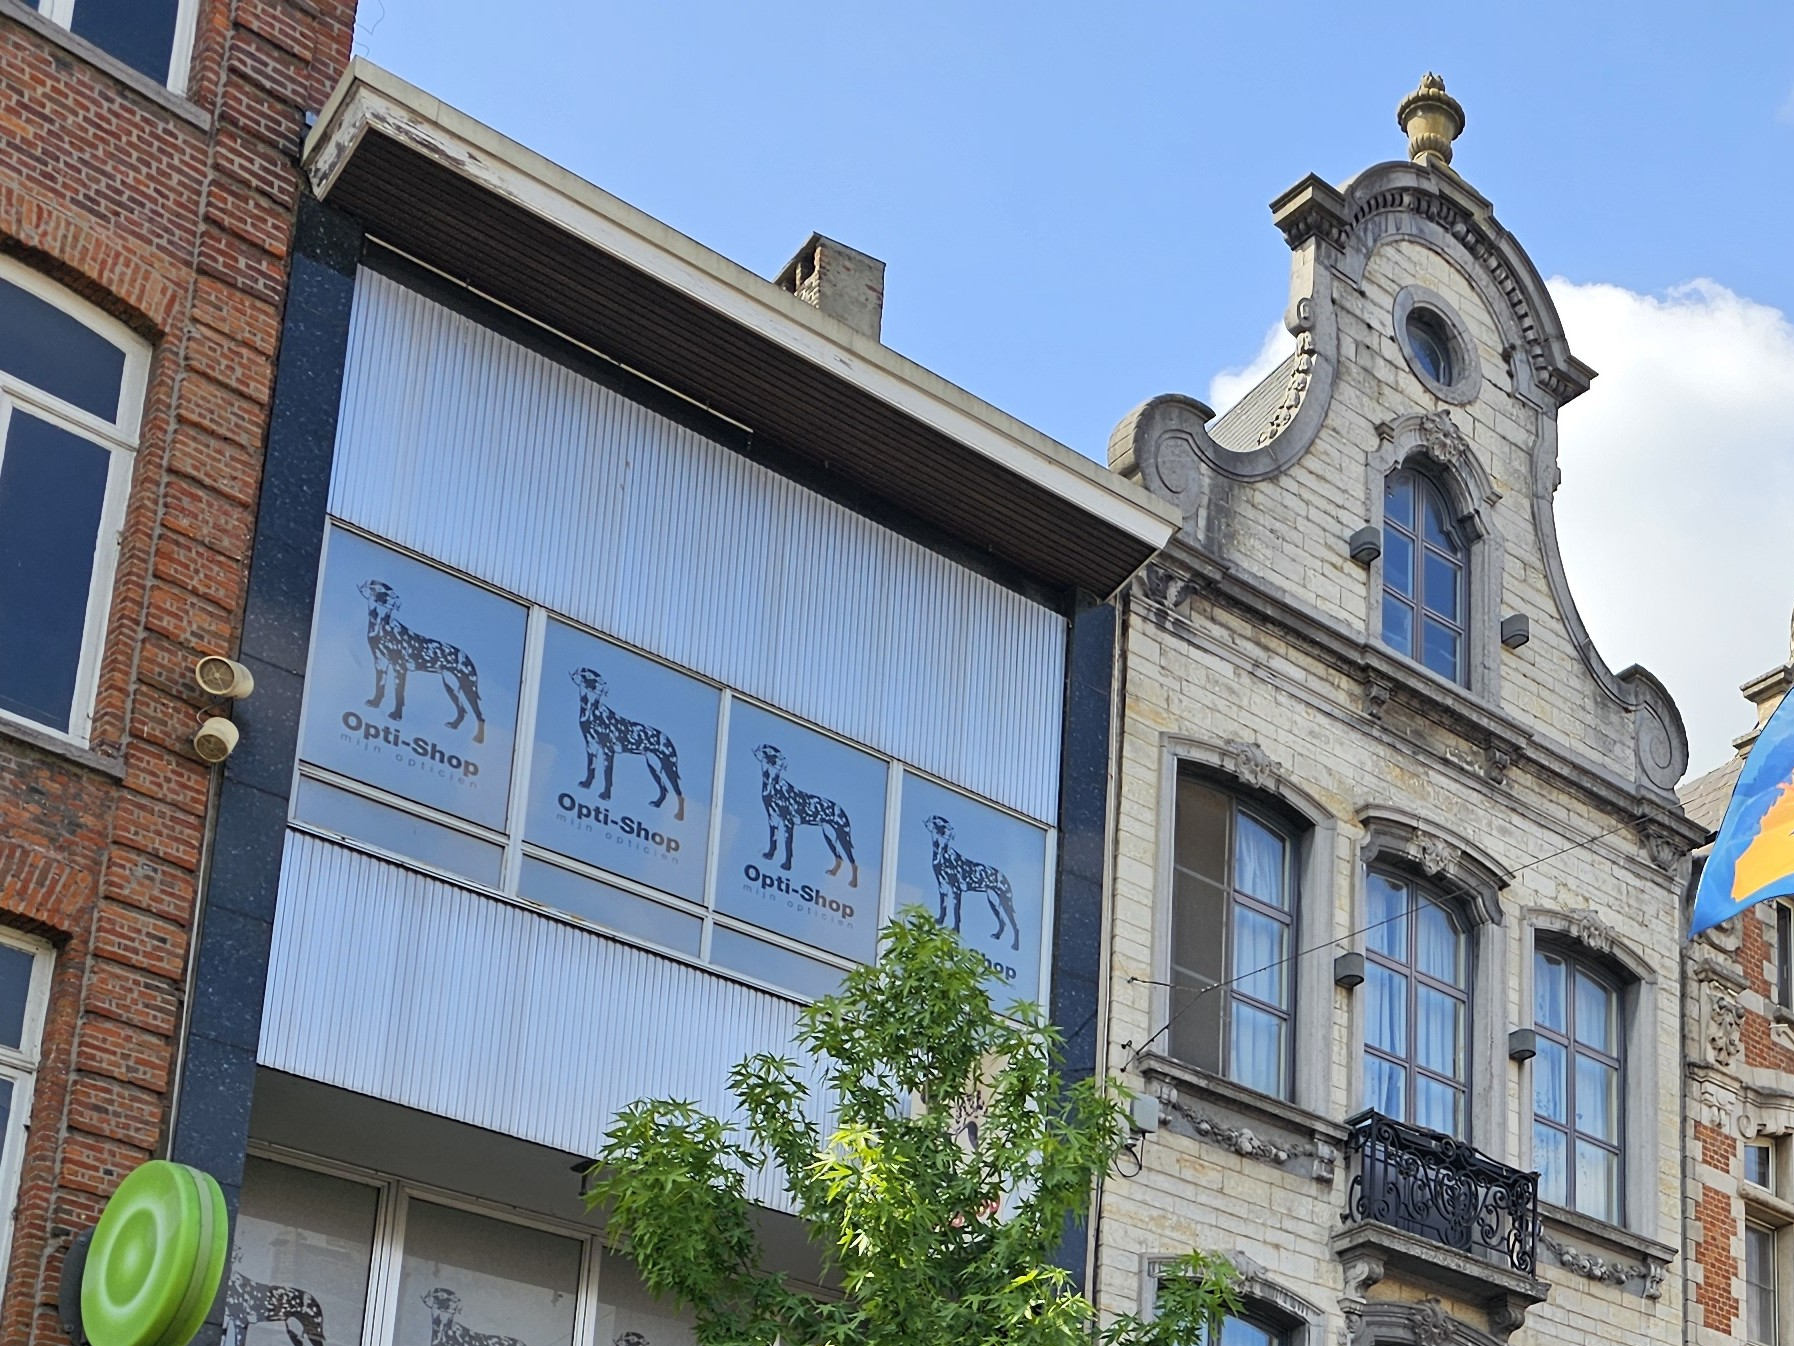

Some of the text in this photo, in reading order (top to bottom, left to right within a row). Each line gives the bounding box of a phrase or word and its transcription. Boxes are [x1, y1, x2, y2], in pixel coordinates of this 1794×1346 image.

[340, 733, 382, 753] mijn
[342, 711, 479, 777] Opti-Shop
[558, 793, 680, 853] Opti-Shop
[744, 864, 854, 919] Opti-Shop
